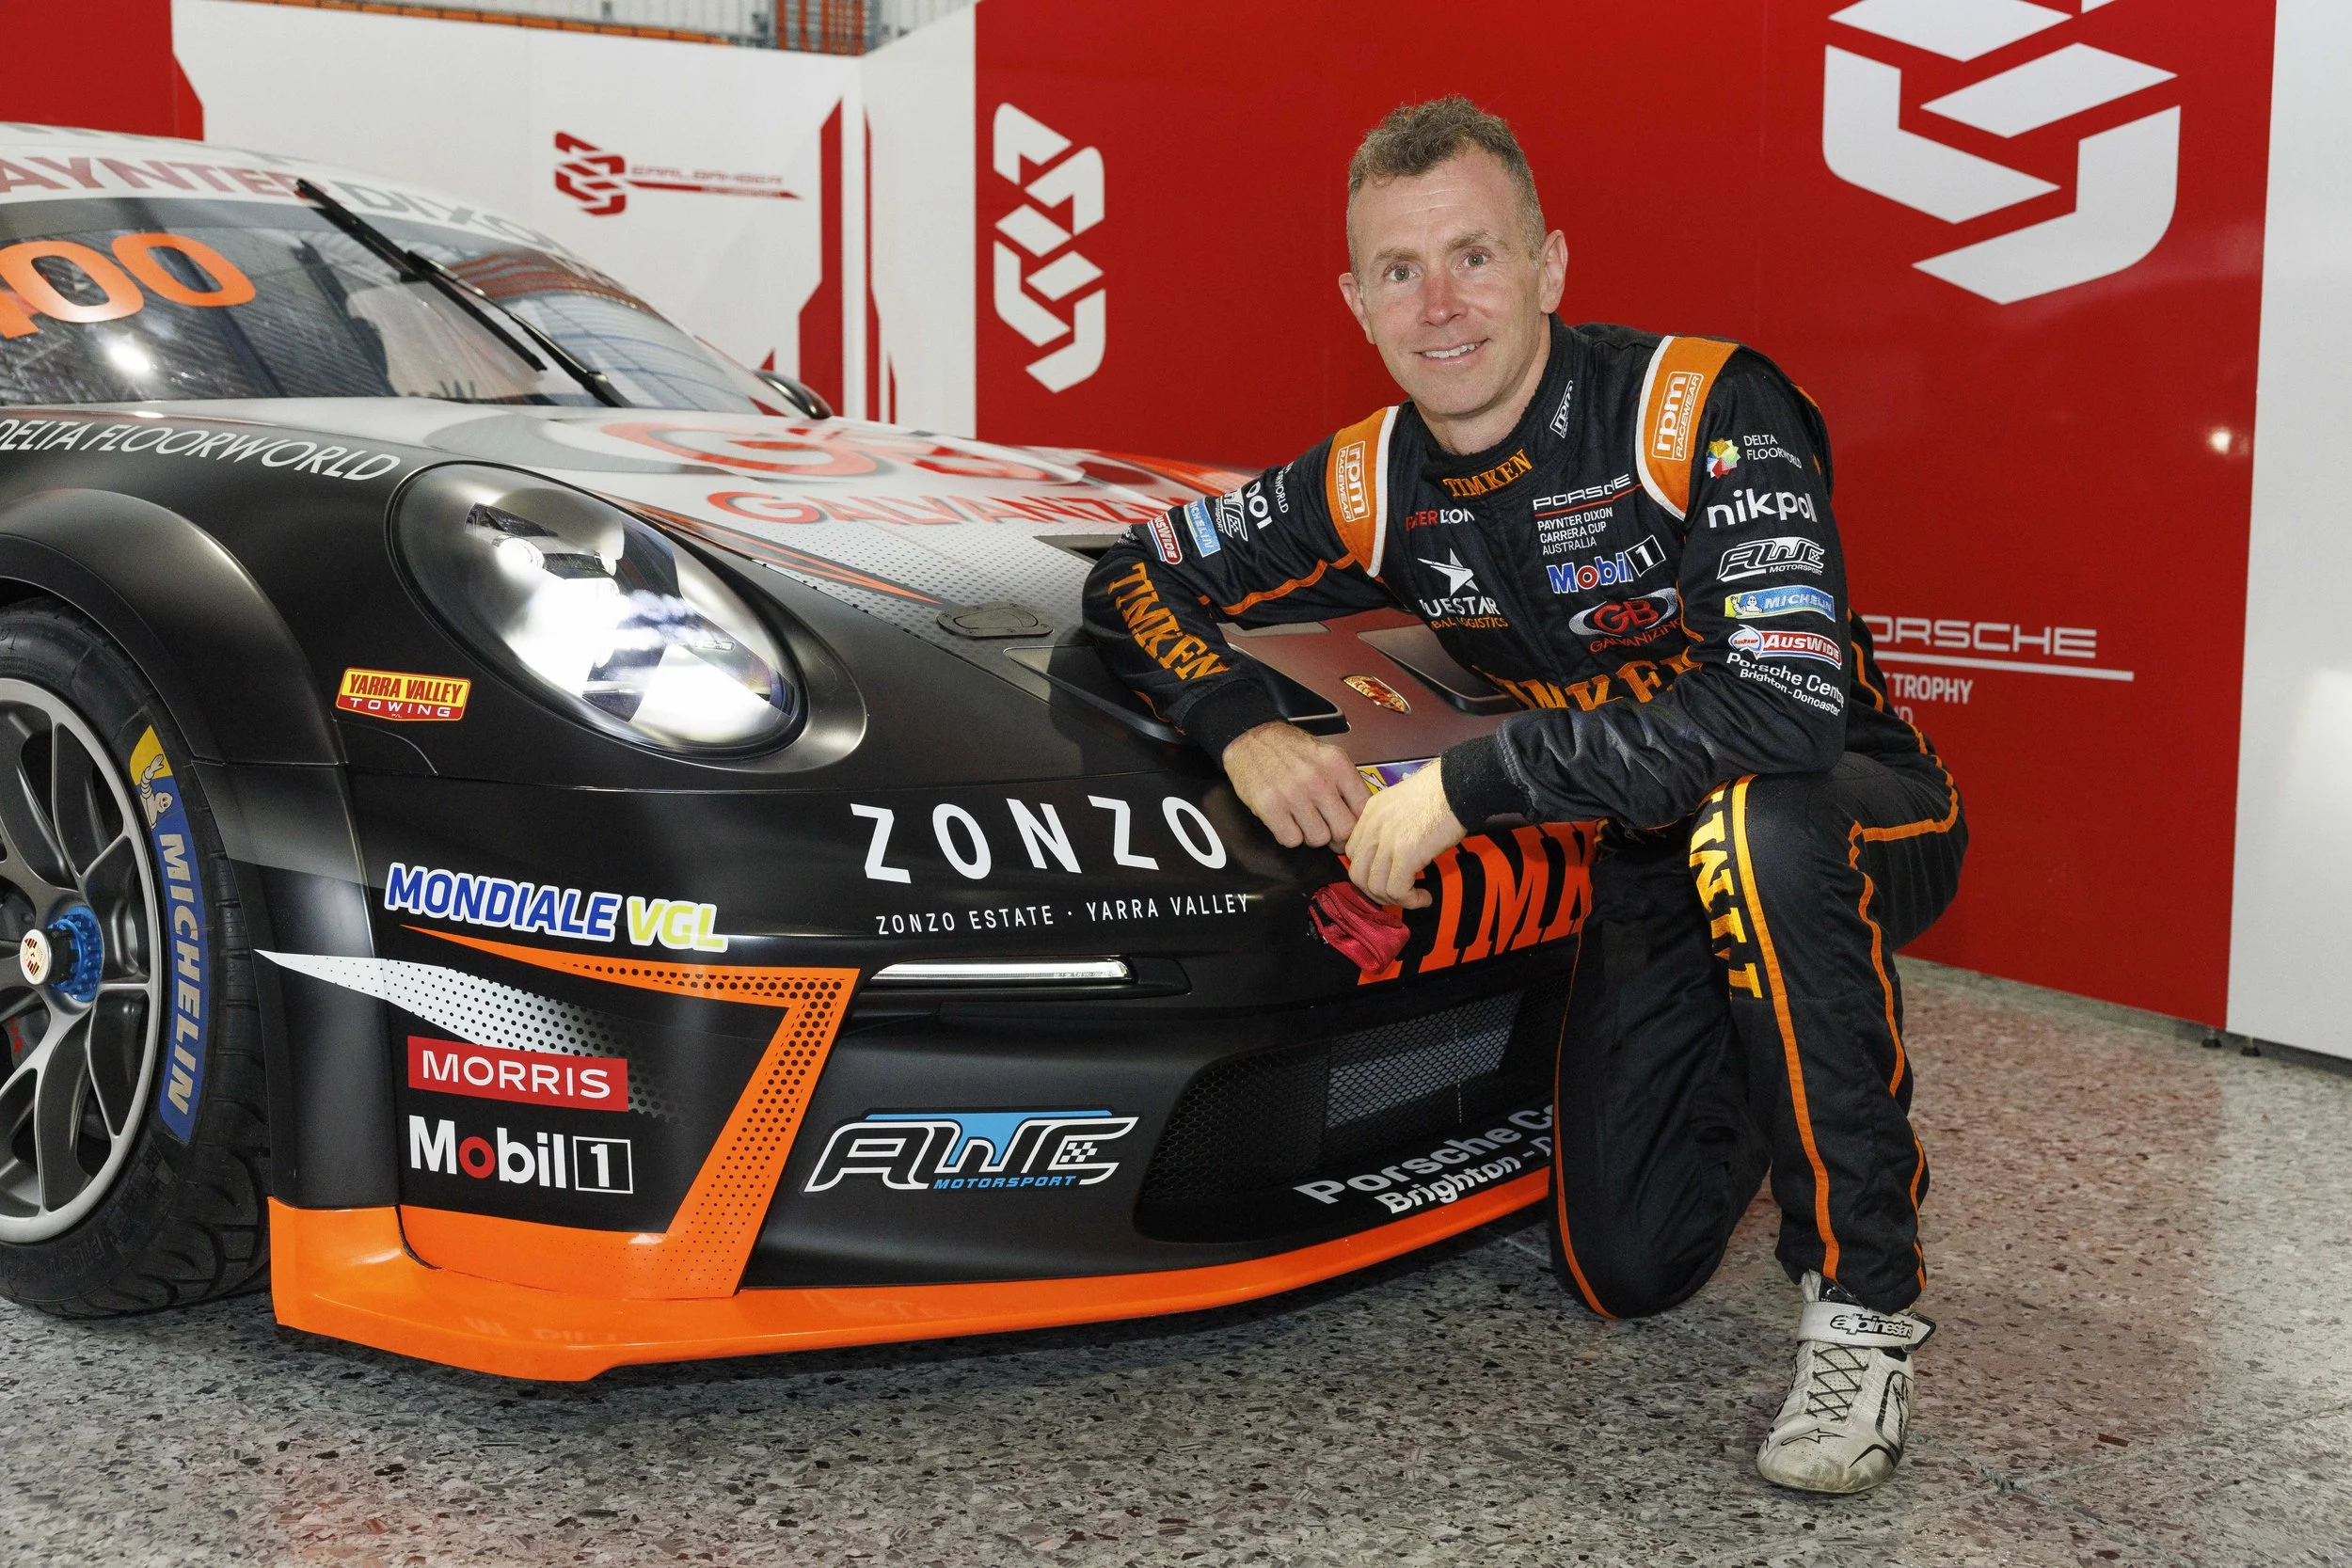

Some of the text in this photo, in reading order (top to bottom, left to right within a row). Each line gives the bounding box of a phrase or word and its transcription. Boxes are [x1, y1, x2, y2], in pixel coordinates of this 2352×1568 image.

[0, 156, 344, 205] AYNTER
[1658, 375, 1687, 451] rpm
[1676, 375, 1700, 458] RACEWEAR
[0, 419, 402, 482] DELTA FLOORWORLD
[1743, 434, 1778, 447] DELTA
[1338, 450, 1352, 520] RACEWEAR
[1346, 447, 1366, 515] rpm
[1442, 448, 1534, 498] TIMKEN
[1537, 507, 1613, 531] PAYNTER DIXON
[1707, 487, 1818, 529] nikpol
[1540, 521, 1607, 544] CARRERA CUP
[1542, 536, 1597, 556] AUSTRALIA
[1546, 551, 1634, 594] Mobil
[1769, 564, 1823, 577] MOTORSPORT
[1107, 562, 1231, 680] TIMKEN
[1419, 595, 1502, 618] UESTAR
[1594, 599, 1659, 634] GB
[1764, 593, 1833, 612] MICHELIN
[1861, 613, 2098, 659] ORSCHE
[349, 673, 464, 705] YARRA VALLEY
[1726, 652, 1803, 686] Porsche
[1891, 672, 1974, 705] TROPHY
[350, 697, 452, 718] TOWING
[850, 794, 1228, 884] ZONZO
[384, 863, 728, 953] MONDIALE VGL
[875, 893, 1249, 936] ZONZO ESTATE YARRA VALLEY
[158, 832, 201, 1117] MICHELIN
[421, 1049, 611, 1099] MORRIS
[408, 1115, 566, 1189] Mobil
[1293, 1127, 1522, 1204] Porsche
[932, 1175, 1077, 1190] MOTORSPORT
[1830, 1312, 1914, 1339] alpinestars
